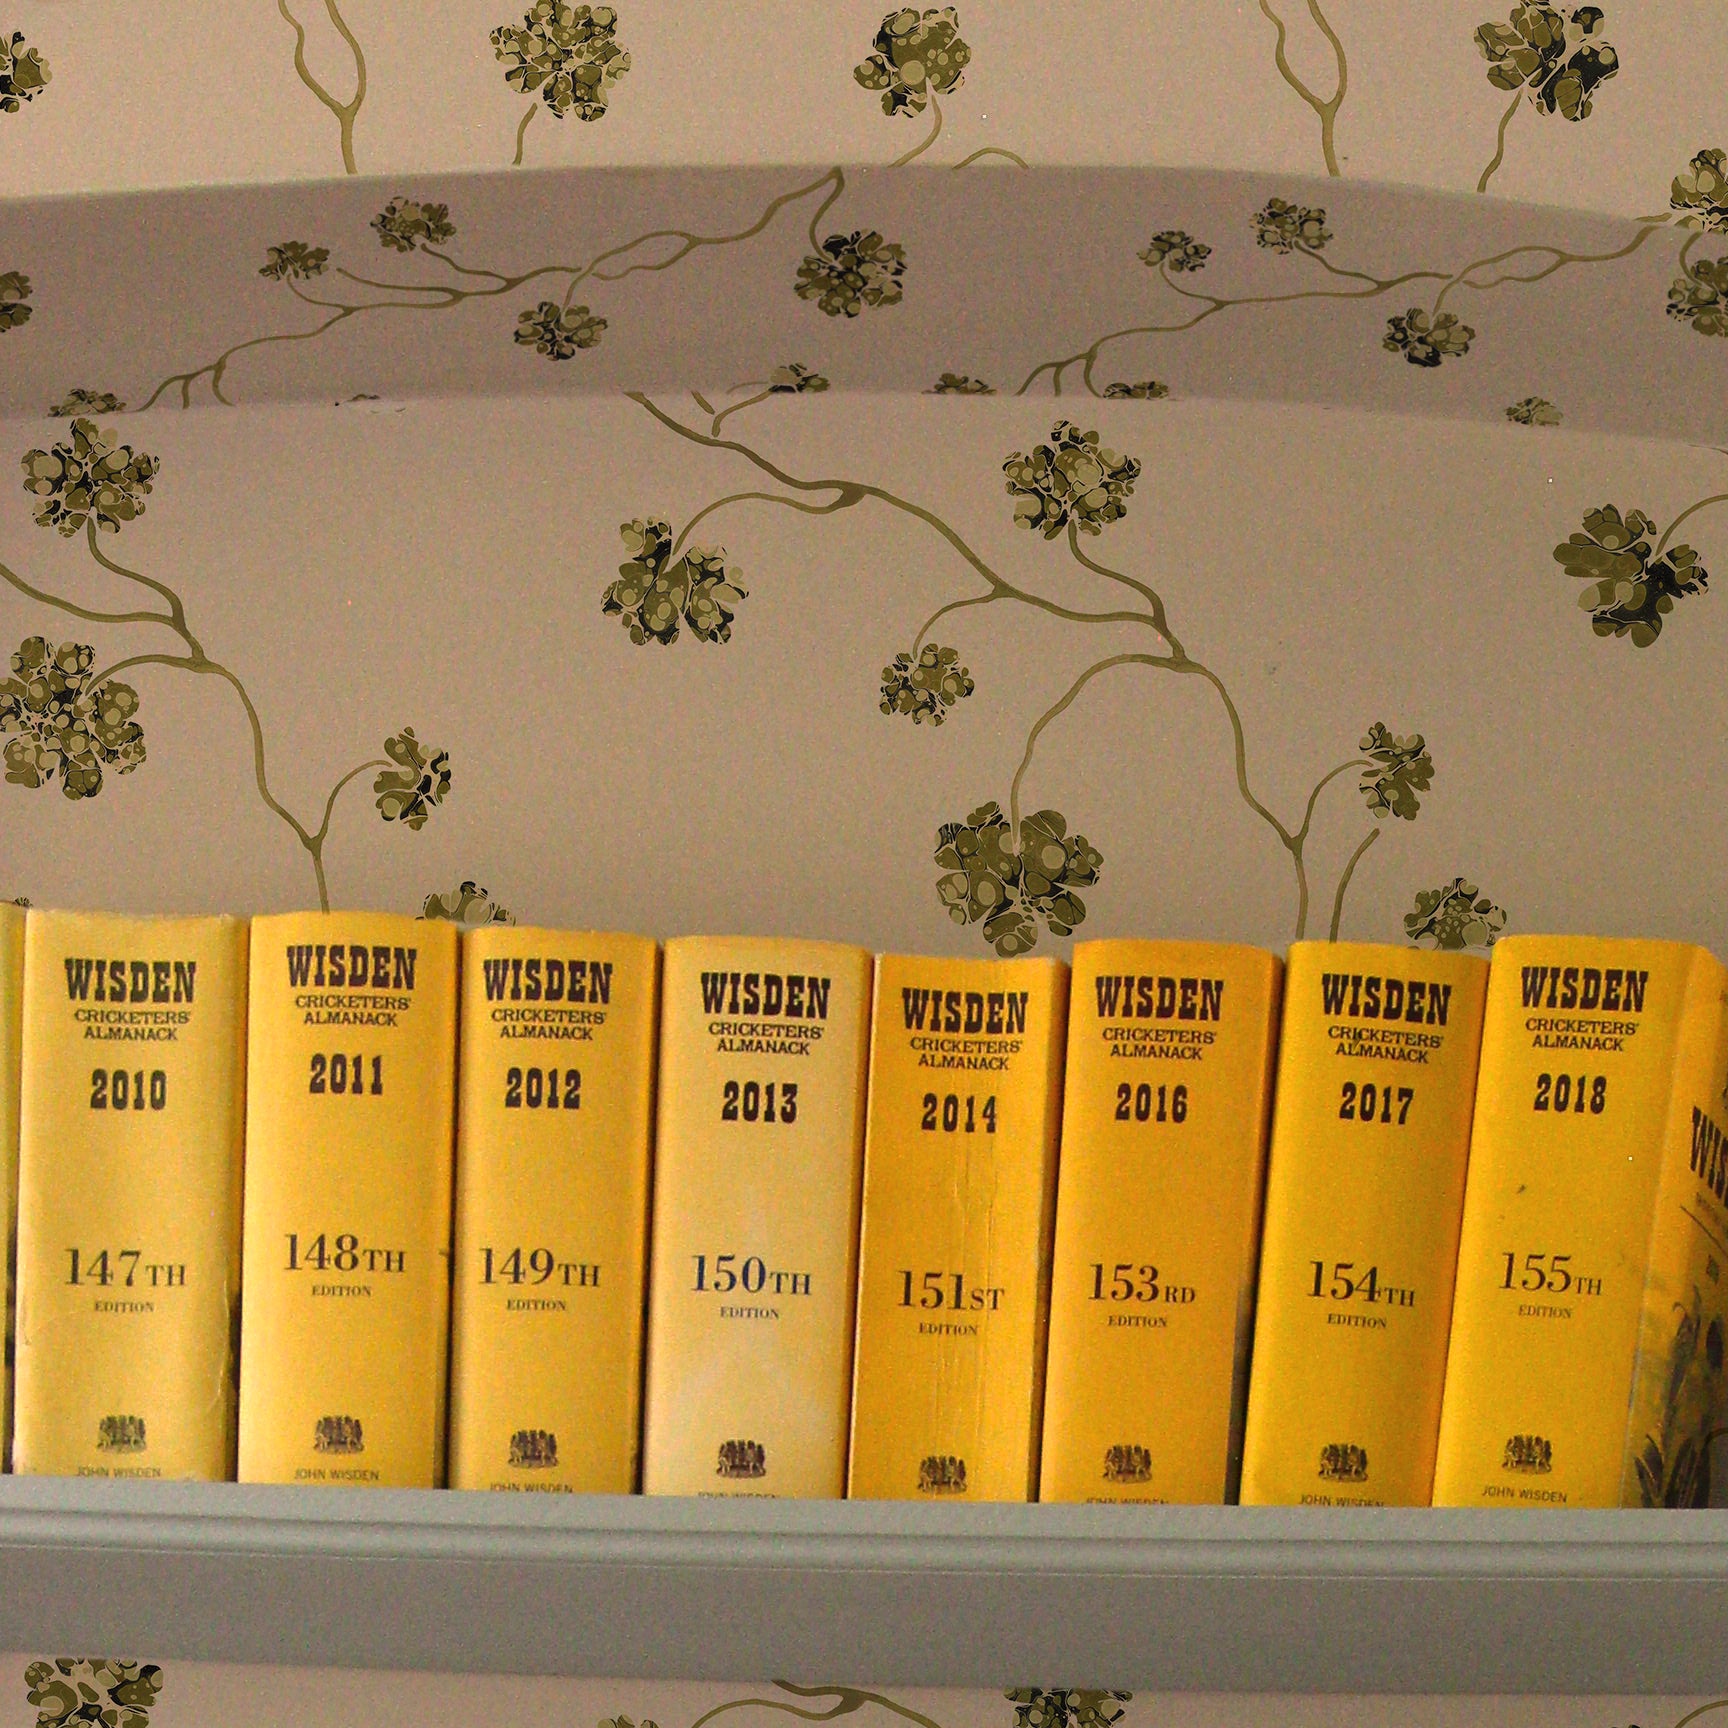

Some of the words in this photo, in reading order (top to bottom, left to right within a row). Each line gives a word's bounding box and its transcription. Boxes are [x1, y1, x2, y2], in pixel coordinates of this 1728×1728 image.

[65, 958, 196, 1003] WISDEN
[287, 945, 417, 990] WISDEN
[483, 959, 612, 1004] WISDEN
[701, 972, 830, 1019] WISDEN
[1096, 976, 1223, 1021] WISDEN
[1322, 974, 1452, 1026] WISDEN
[1522, 967, 1648, 1012] WISDEN
[304, 1009, 397, 1027] ALMANACK
[902, 988, 1028, 1034] WISDEN
[84, 1026, 177, 1041] ALMANACK
[500, 1025, 593, 1040] ALMANACK
[717, 1038, 809, 1055] ALMANACK
[1532, 1034, 1624, 1051] ALMANACK
[918, 1054, 1009, 1070] ALMANACK
[1110, 1044, 1202, 1060] ALMANACK
[1336, 1043, 1429, 1065] ALMANACK
[90, 1069, 166, 1110] 2010
[309, 1053, 382, 1095] 2011
[505, 1067, 581, 1109] 2012
[722, 1081, 797, 1124] 2013
[1115, 1083, 1187, 1123] 2016
[1339, 1082, 1413, 1124] 2017
[1534, 1073, 1606, 1114] 2018
[922, 1093, 996, 1133] 2014
[66, 1249, 185, 1287] 147TH
[285, 1234, 404, 1272] 148TH
[480, 1248, 599, 1286] 149TH
[312, 1285, 371, 1297] EDITION
[693, 1255, 810, 1295] 150TH
[899, 1271, 1004, 1310] 151ST
[1088, 1264, 1195, 1303] 153RD
[1308, 1261, 1414, 1306] 154TH
[1499, 1252, 1601, 1295] 155TH
[94, 1301, 153, 1313] EDITION
[507, 1299, 566, 1310] EDITION
[721, 1307, 779, 1319] EDITION
[1108, 1316, 1167, 1328] EDITION
[1327, 1313, 1386, 1328] EDITION
[1518, 1304, 1572, 1318] EDITION
[919, 1323, 977, 1336] EDITION
[294, 1469, 326, 1480] JOHN
[330, 1470, 379, 1482] WISDEN
[1482, 1486, 1514, 1498] JOHN
[1520, 1489, 1567, 1503] WISDEN
